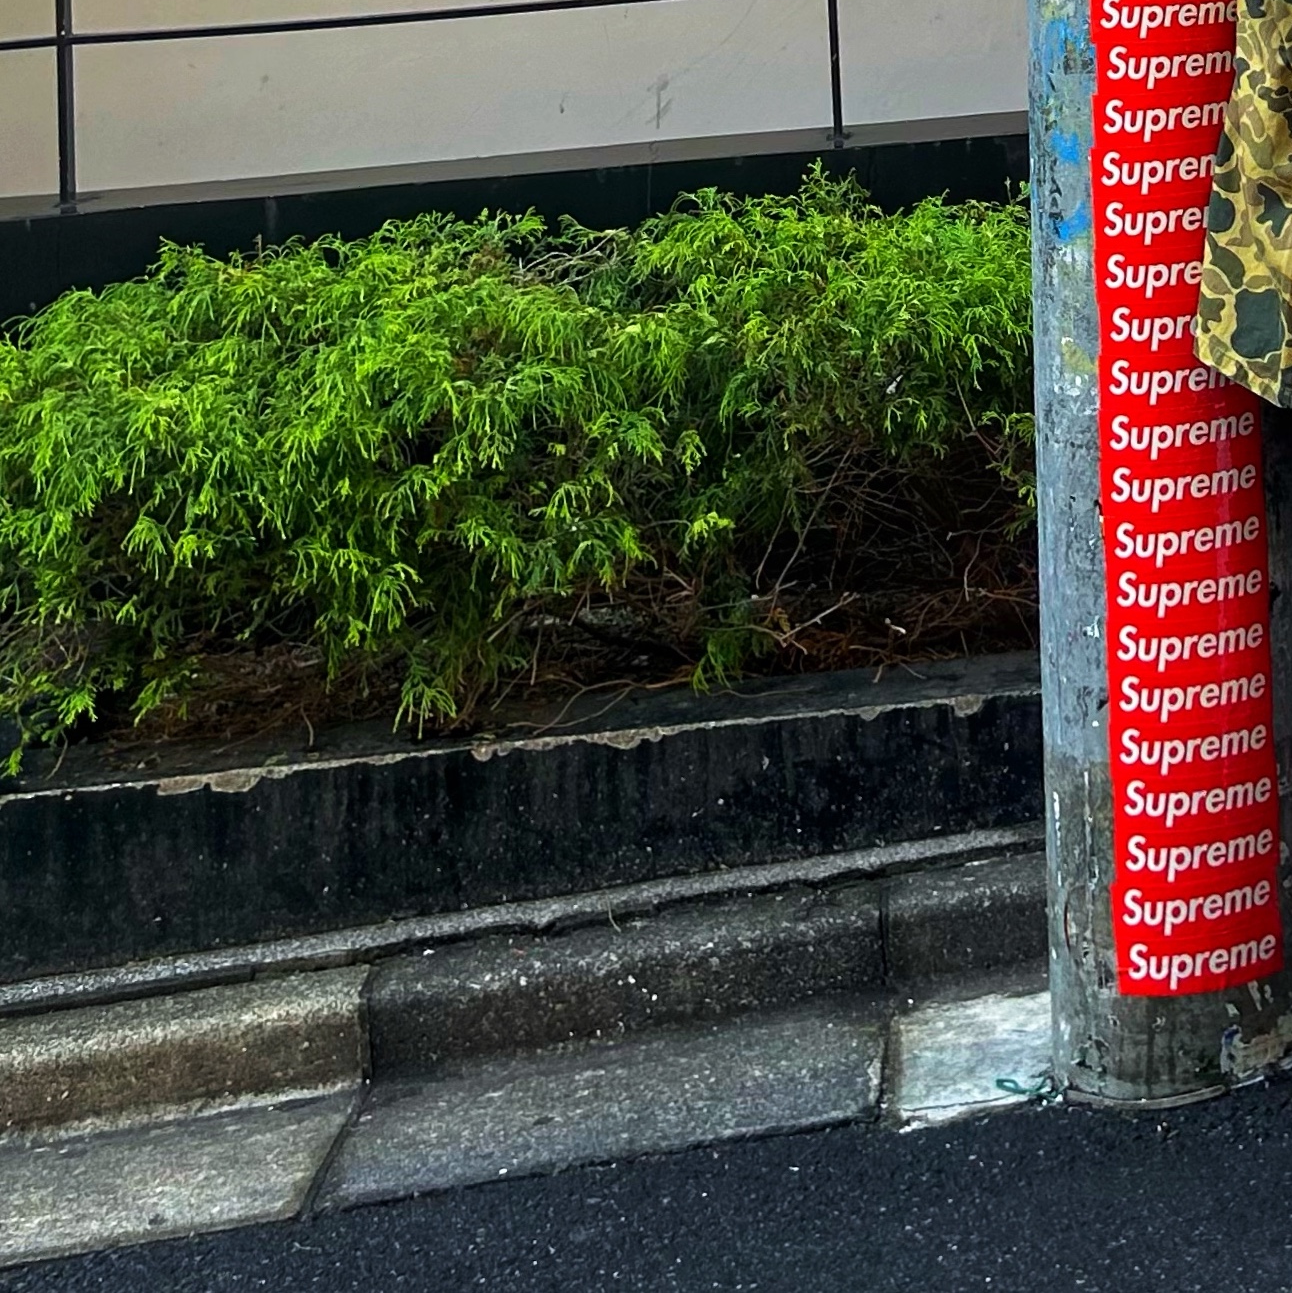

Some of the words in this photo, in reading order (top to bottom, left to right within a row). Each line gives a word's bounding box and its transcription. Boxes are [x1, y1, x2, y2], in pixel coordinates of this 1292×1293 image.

[1104, 202, 1209, 245] Supre
[1110, 412, 1255, 460] Supreme
[1111, 464, 1257, 512] Supreme
[1115, 516, 1260, 567] Supreme
[1117, 570, 1262, 618] Supreme
[1116, 624, 1263, 672] Supreme
[1119, 673, 1266, 722] Supreme
[1119, 724, 1267, 775] Supreme
[1124, 777, 1271, 827] Supreme
[1125, 829, 1273, 882] Supreme
[1122, 880, 1270, 935] Supreme
[1128, 935, 1276, 989] Supreme
